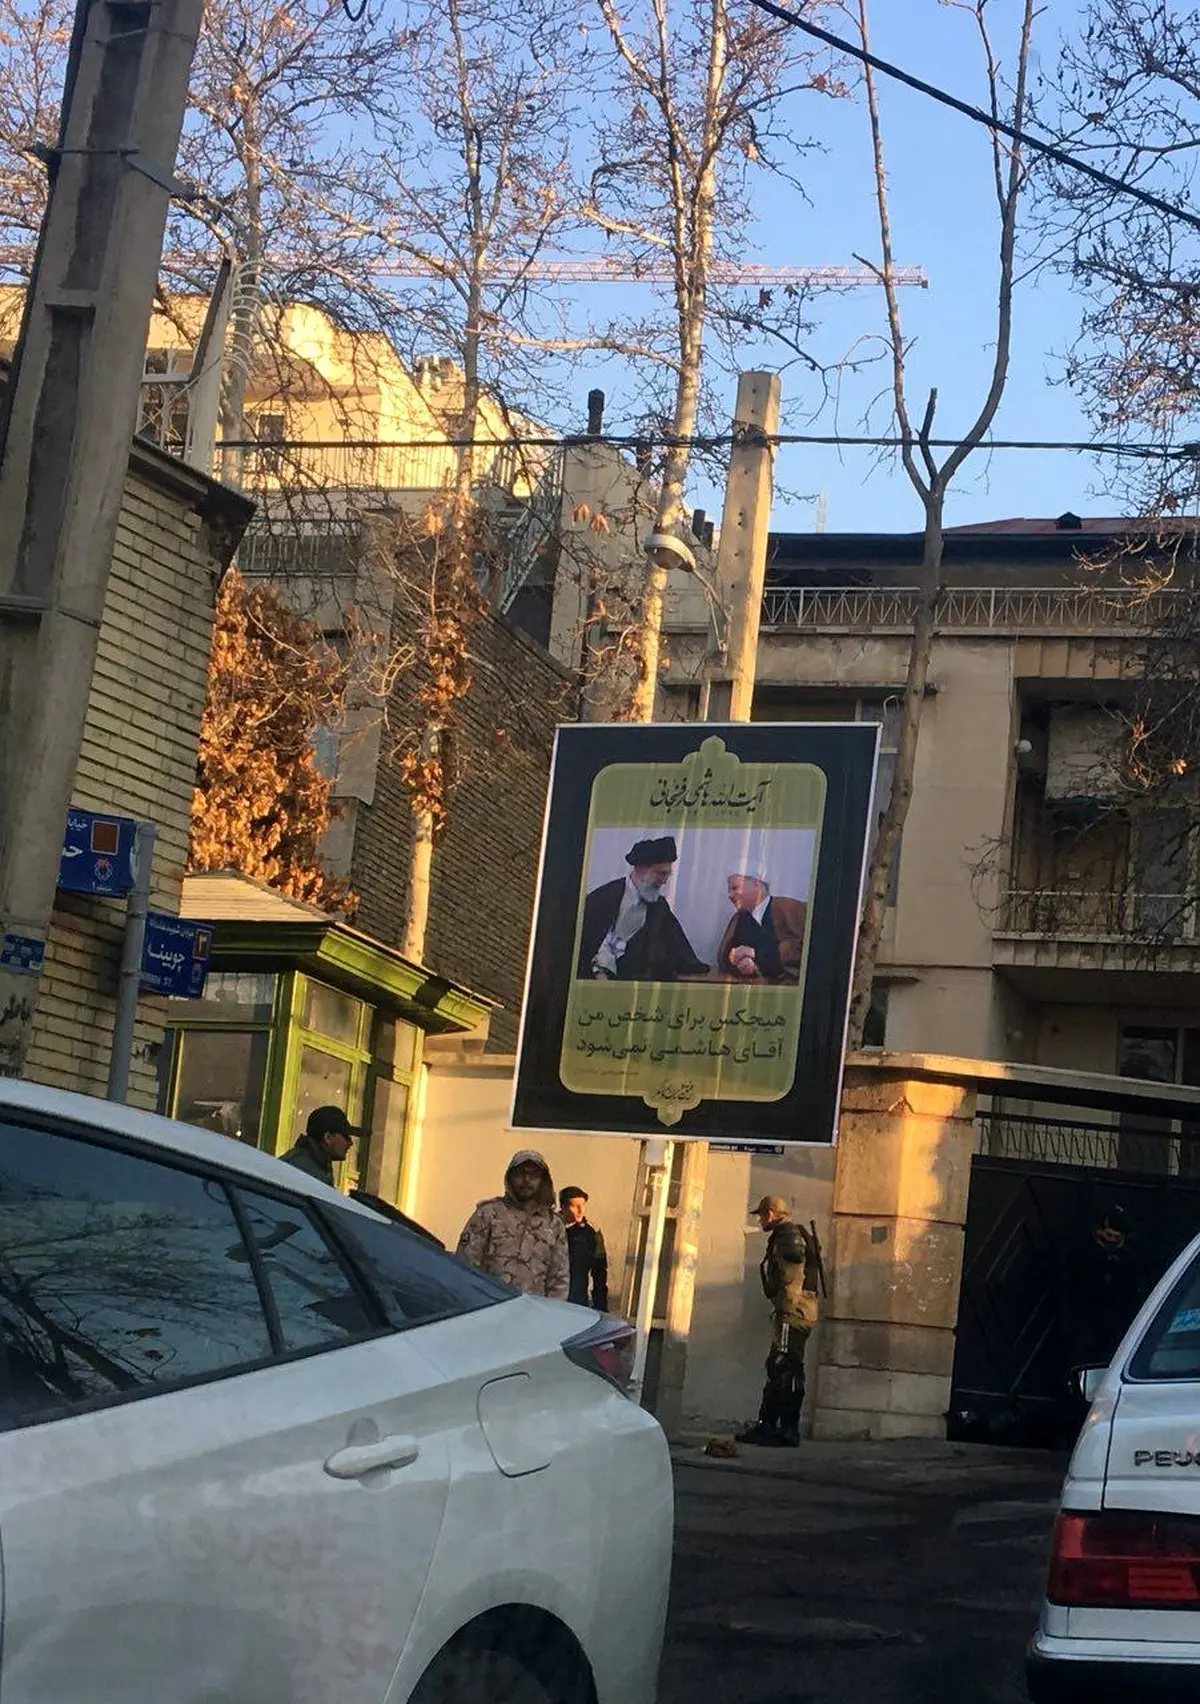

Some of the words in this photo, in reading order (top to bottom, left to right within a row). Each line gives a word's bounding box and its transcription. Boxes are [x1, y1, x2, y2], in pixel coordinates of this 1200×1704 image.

[578, 1008, 604, 1028] من
[608, 1006, 664, 1028] شخص
[667, 1007, 705, 1030] برای
[709, 1009, 786, 1032] هیچکس
[649, 1038, 732, 1061] هاشمی
[733, 1036, 785, 1063] آقای
